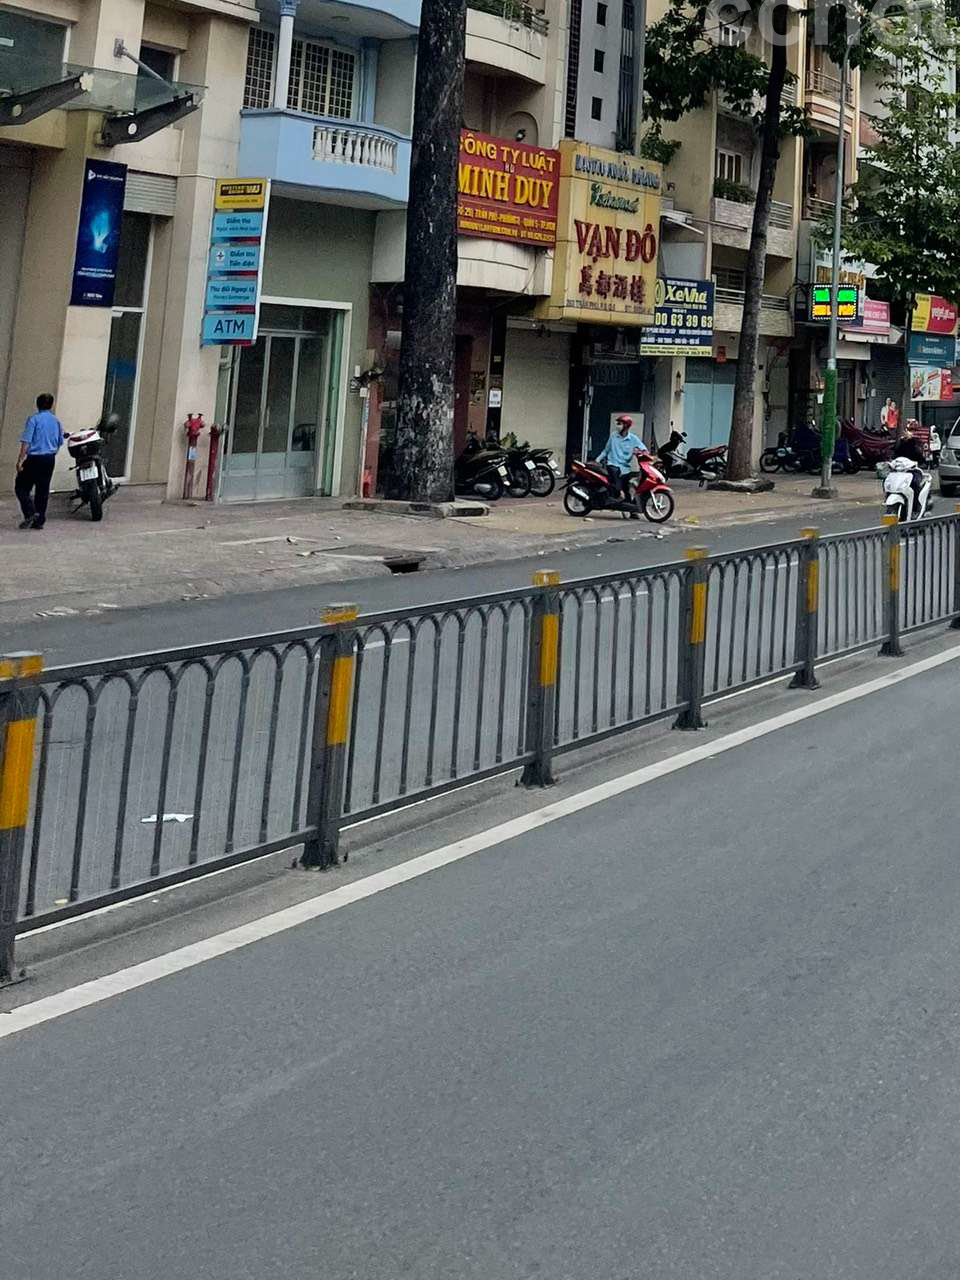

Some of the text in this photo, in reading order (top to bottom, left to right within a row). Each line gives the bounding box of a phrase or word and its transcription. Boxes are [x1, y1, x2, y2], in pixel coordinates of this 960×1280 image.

[501, 146, 520, 164] TY
[521, 150, 556, 176] LUẬT
[458, 162, 554, 209] MINH DUY
[574, 219, 657, 264] VẠN ĐÔ
[213, 319, 245, 334] ATM
[670, 313, 683, 327] 63
[686, 314, 698, 328] 39
[701, 315, 713, 328] 63
